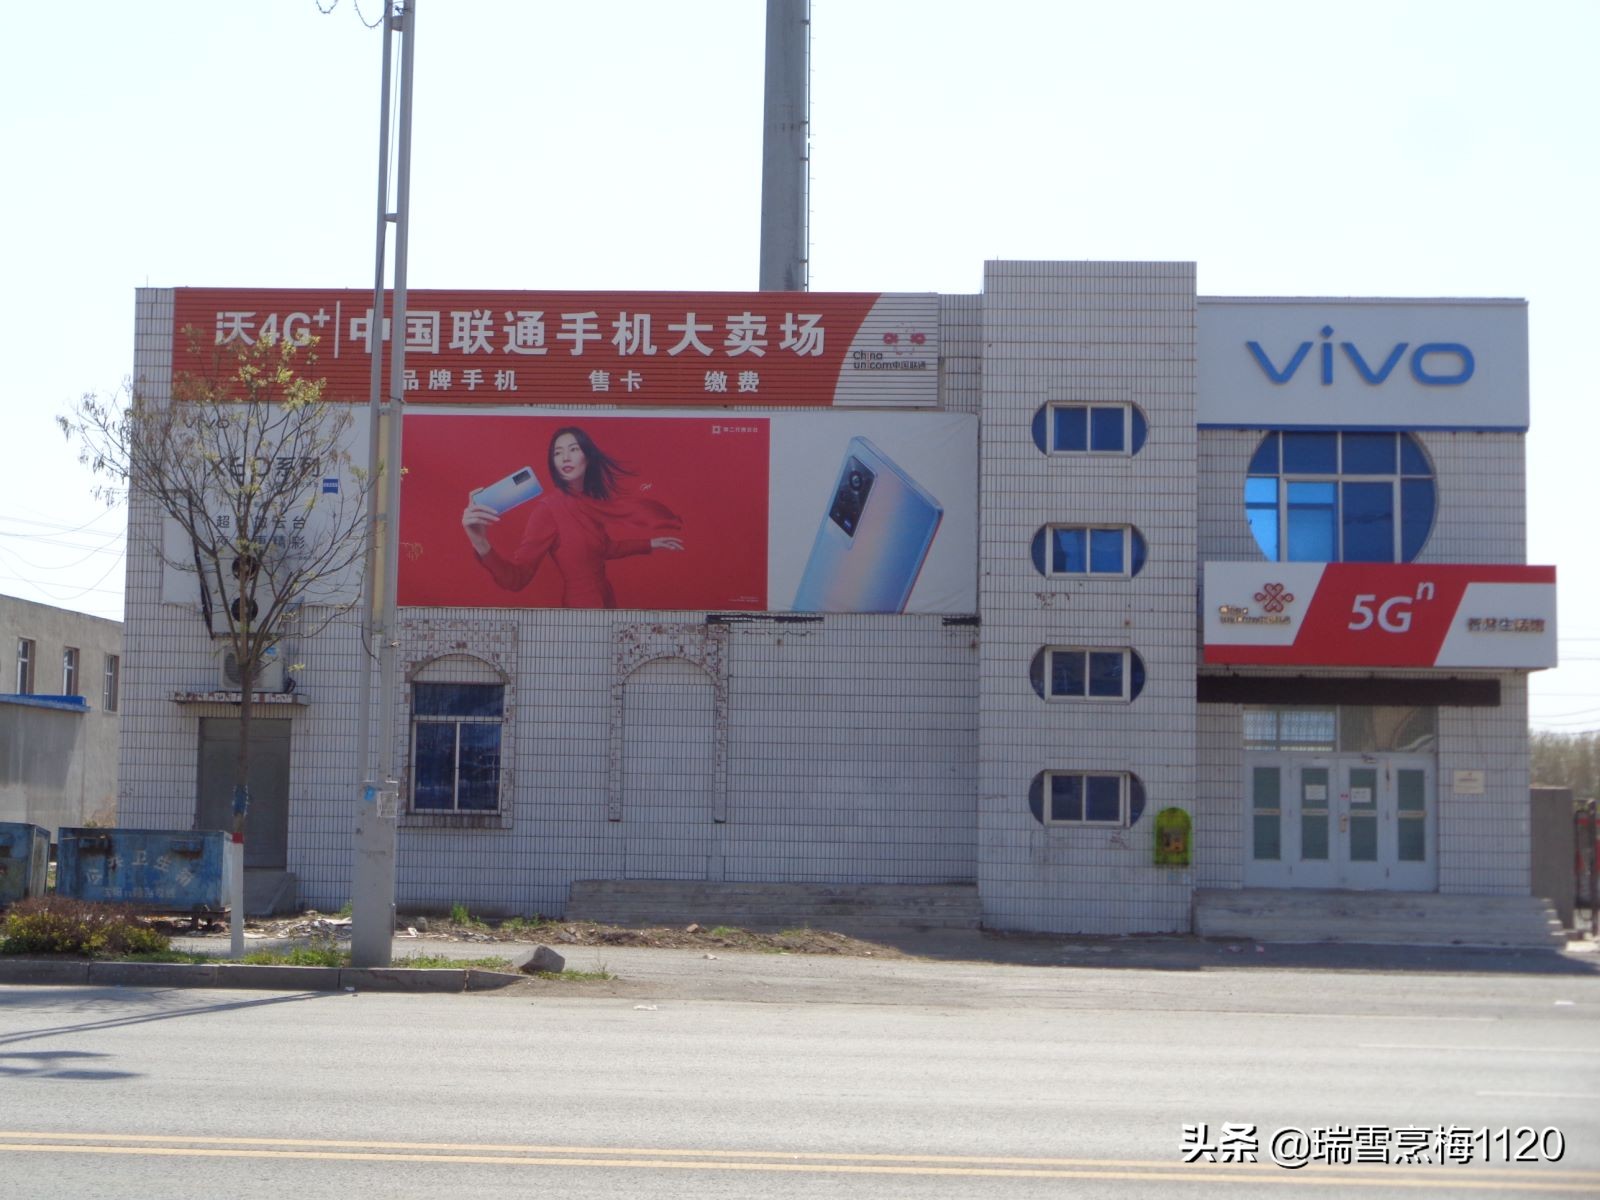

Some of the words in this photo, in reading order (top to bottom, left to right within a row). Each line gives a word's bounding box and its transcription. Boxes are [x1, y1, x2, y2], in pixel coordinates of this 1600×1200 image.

[350, 309, 825, 357] 中国联通手机大卖场
[1246, 325, 1475, 386] vivo
[588, 370, 643, 392] 售卡
[704, 370, 760, 393] 缴费
